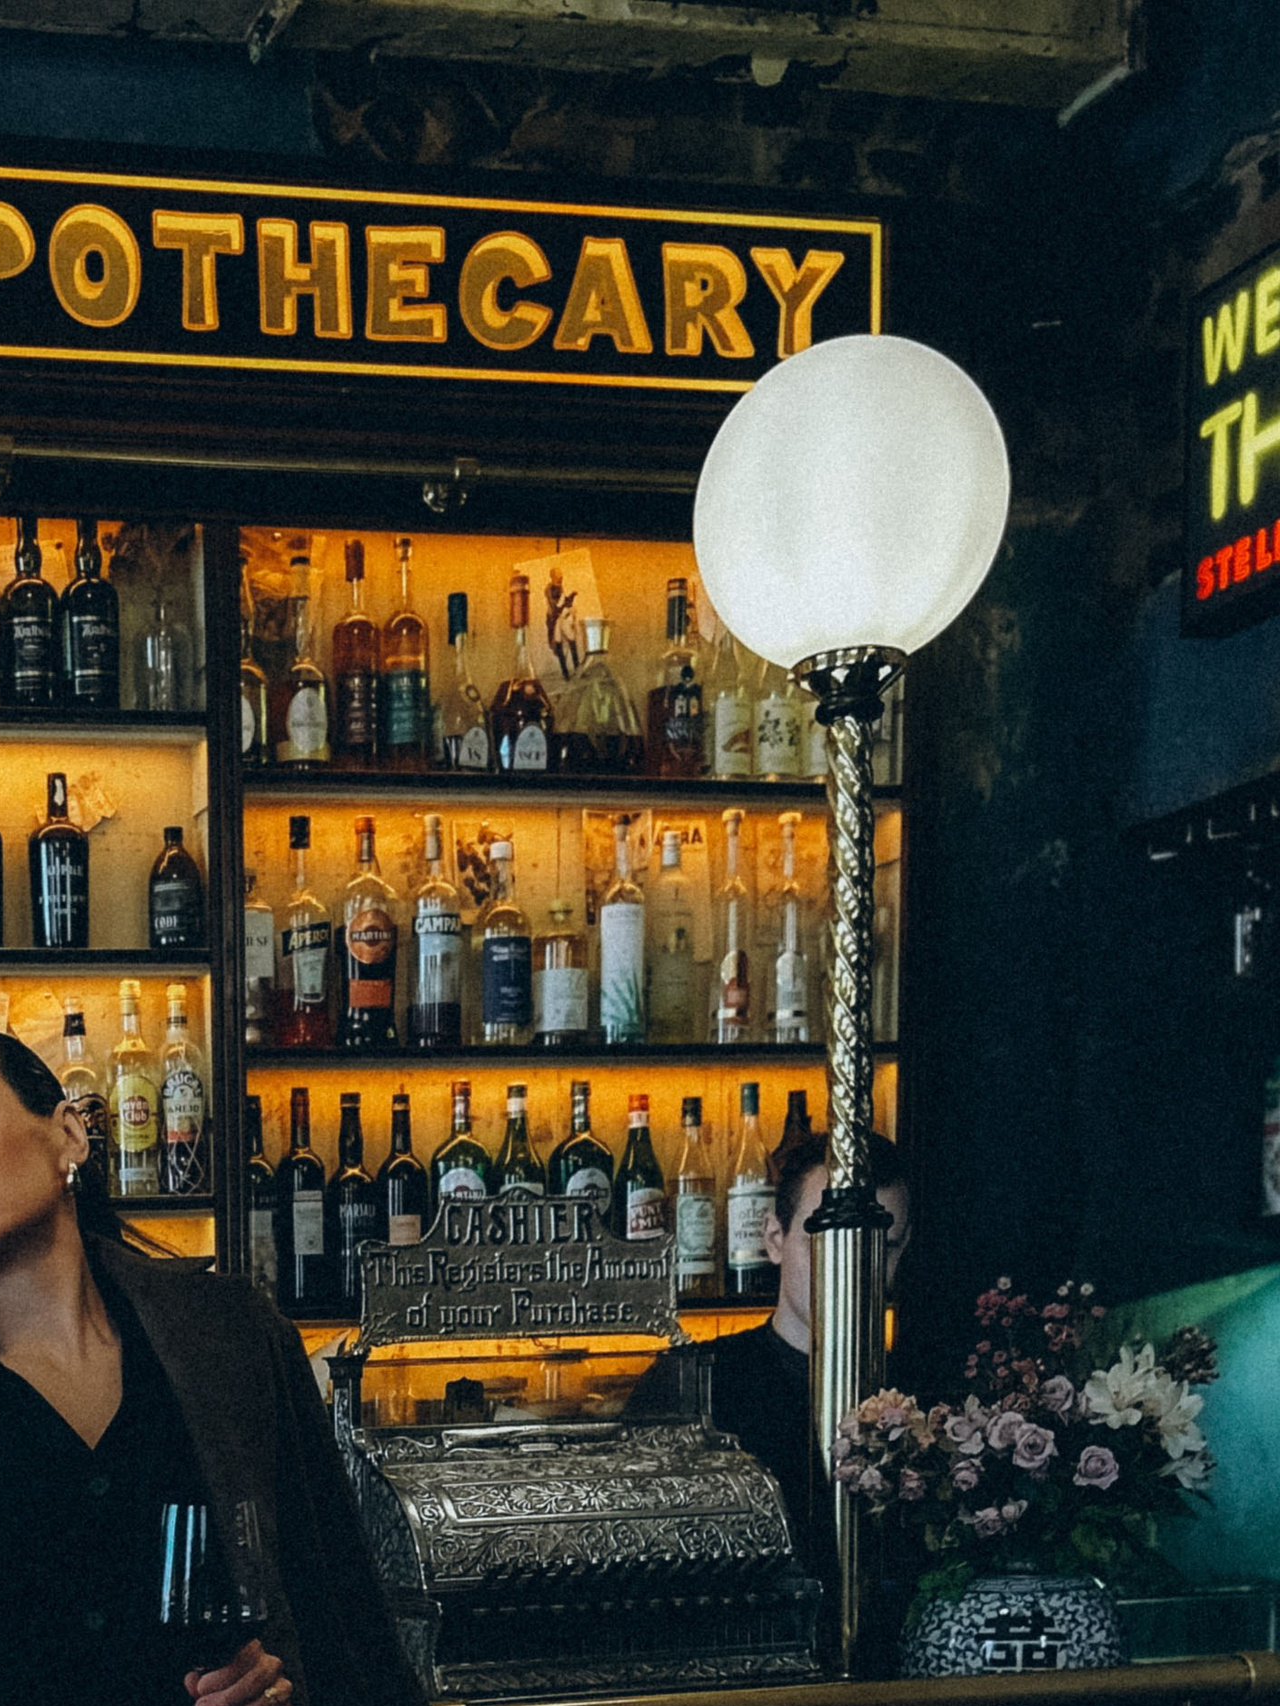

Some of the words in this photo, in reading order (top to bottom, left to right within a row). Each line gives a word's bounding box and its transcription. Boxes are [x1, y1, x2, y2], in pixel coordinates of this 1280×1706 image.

[368, 1249, 426, 1288] This
[428, 1249, 541, 1293] Registers
[545, 1245, 584, 1283] the
[582, 1244, 672, 1289] Amount
[406, 1291, 432, 1329] of
[439, 1303, 502, 1334] your
[510, 1287, 641, 1326] Purchase.
